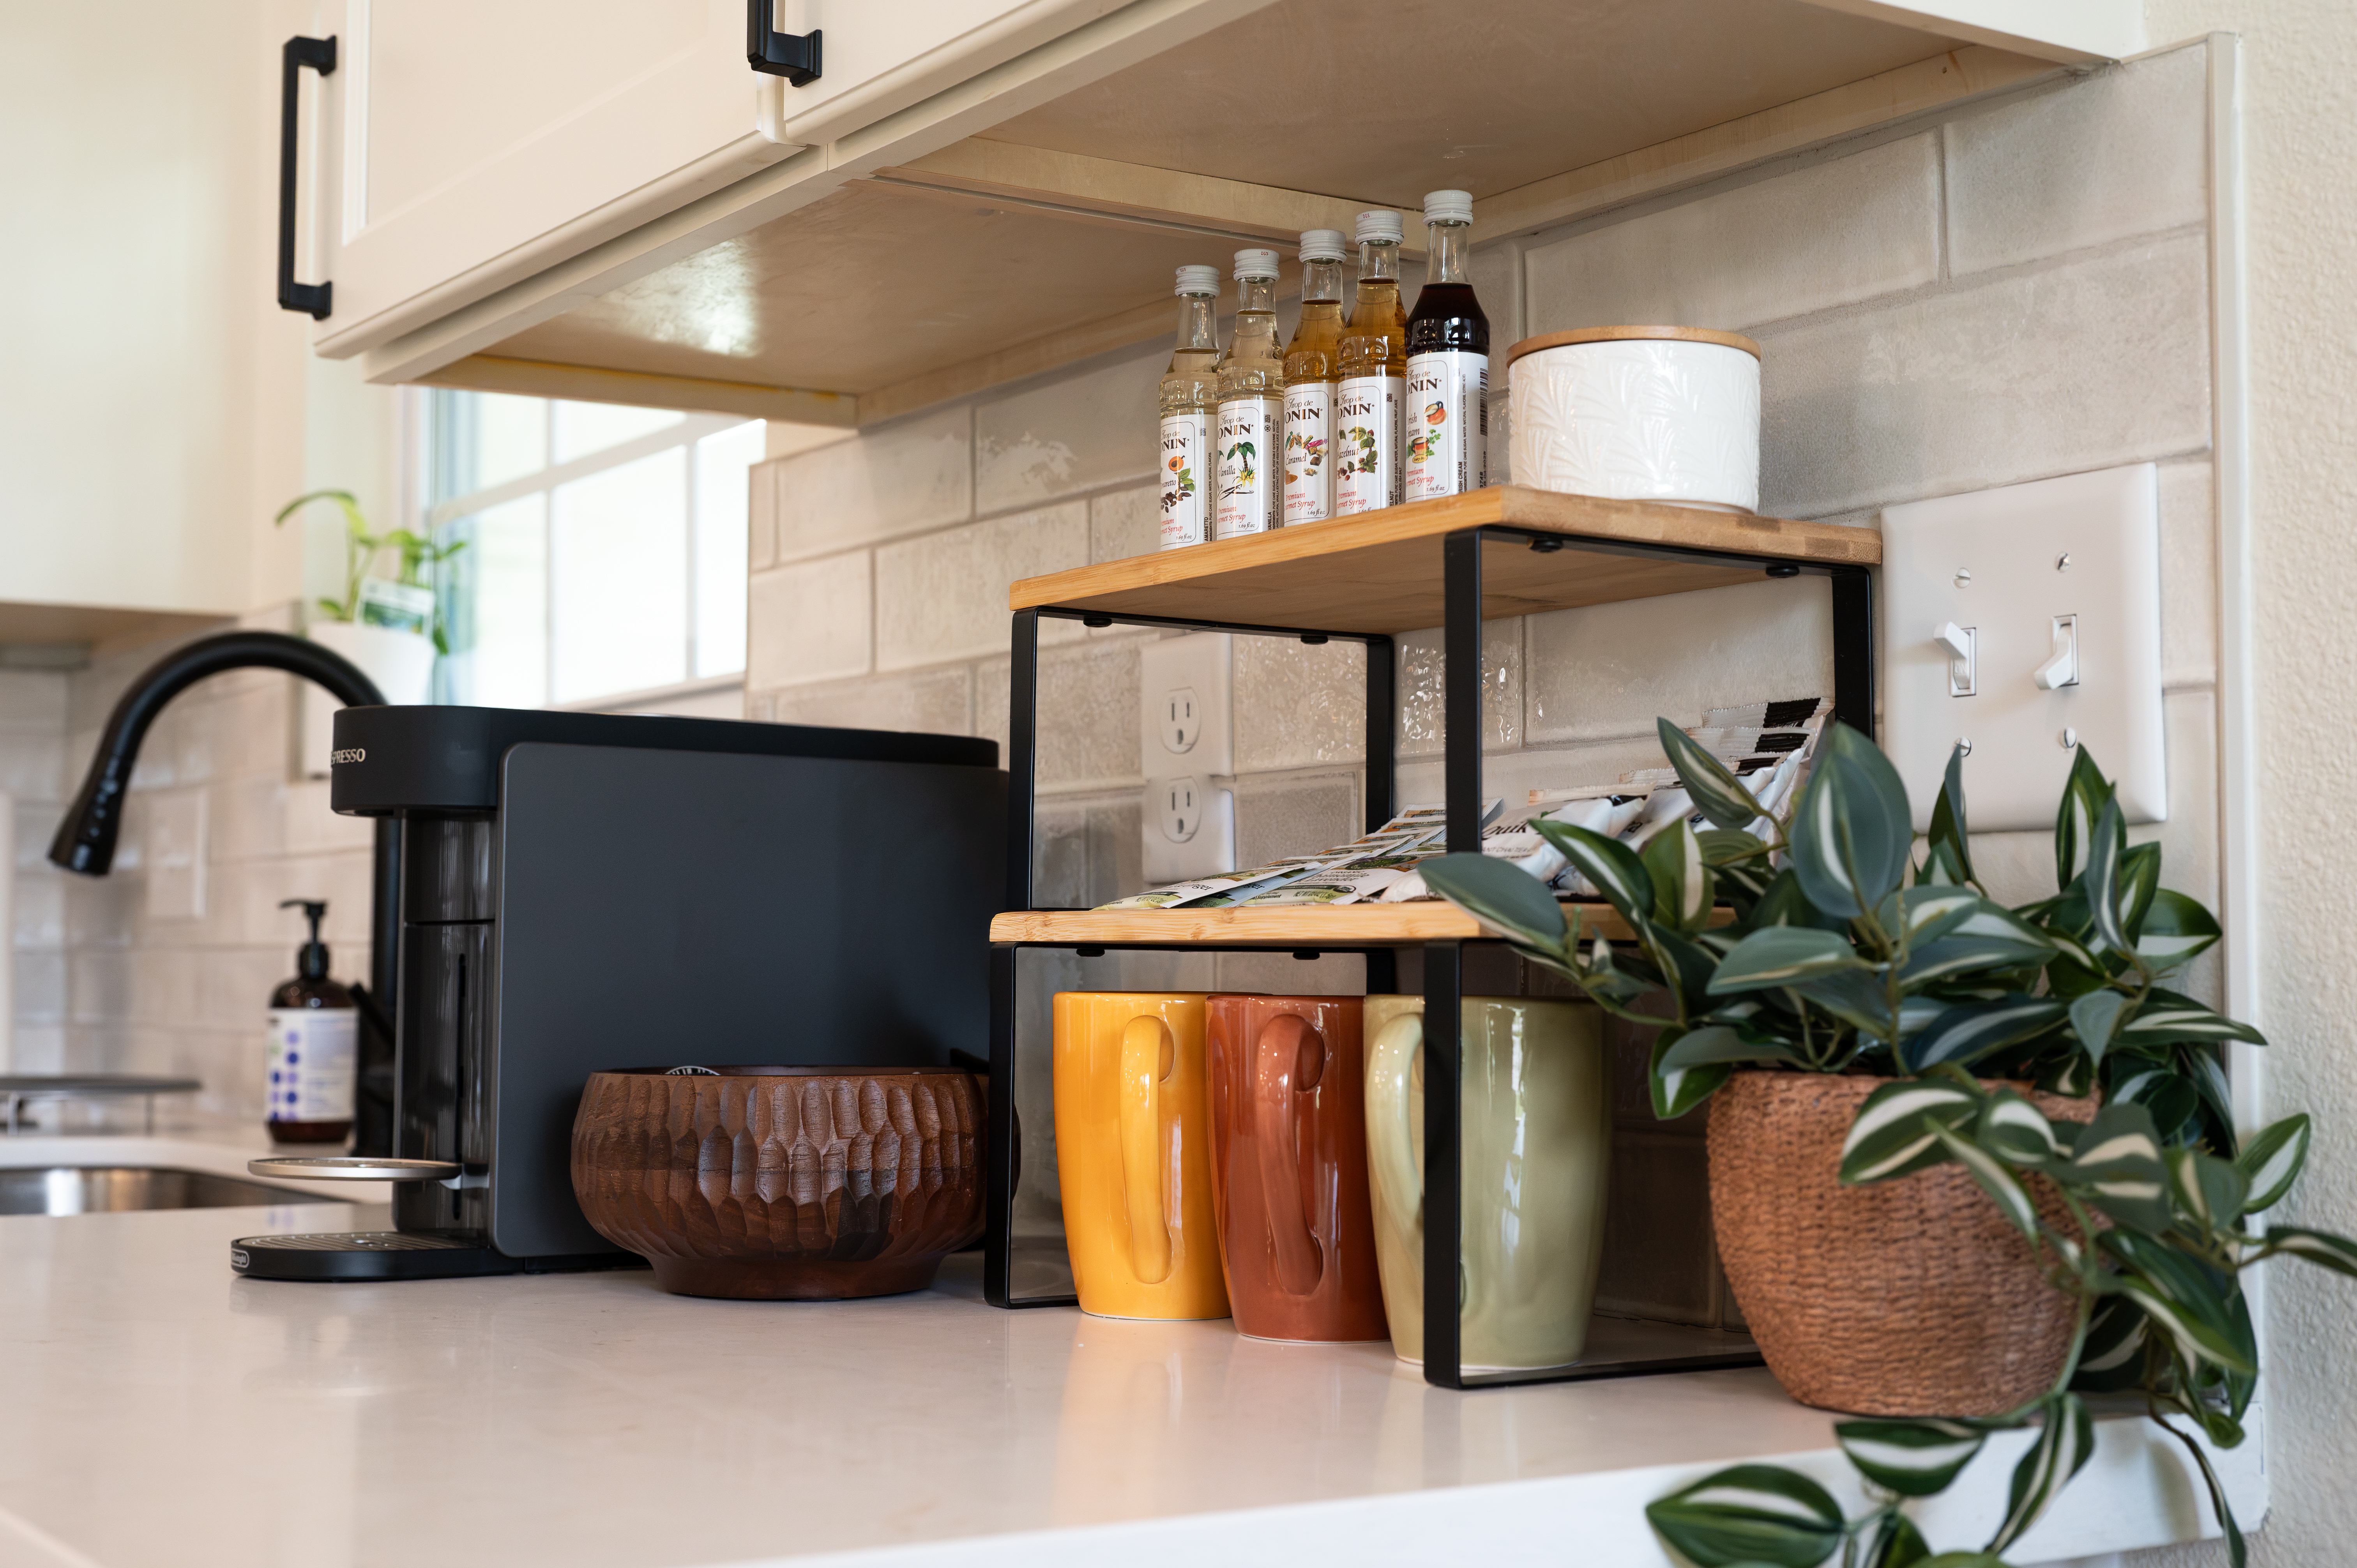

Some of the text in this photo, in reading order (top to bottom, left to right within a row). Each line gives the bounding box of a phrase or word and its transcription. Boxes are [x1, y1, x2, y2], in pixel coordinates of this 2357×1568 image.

[1287, 398, 1302, 410] Sirop
[1340, 394, 1353, 406] Sirop
[1285, 408, 1320, 424] ONIN
[1338, 403, 1371, 419] ONIN
[1220, 415, 1234, 426] Sirop
[1218, 424, 1251, 440] ONIN
[1286, 452, 1307, 466] Caramel
[1218, 465, 1236, 477] Vanilla
[1417, 476, 1434, 487] Syrup
[1434, 484, 1440, 493] fl
[1286, 491, 1305, 501] Premium
[1338, 490, 1356, 500] Premium
[1298, 500, 1315, 510] Syrup
[1349, 499, 1366, 510] Syrup
[1229, 514, 1246, 524] Syrup
[1168, 526, 1183, 535] Syrup
[1245, 522, 1251, 530] fl
[331, 748, 366, 764] SPRESSO
